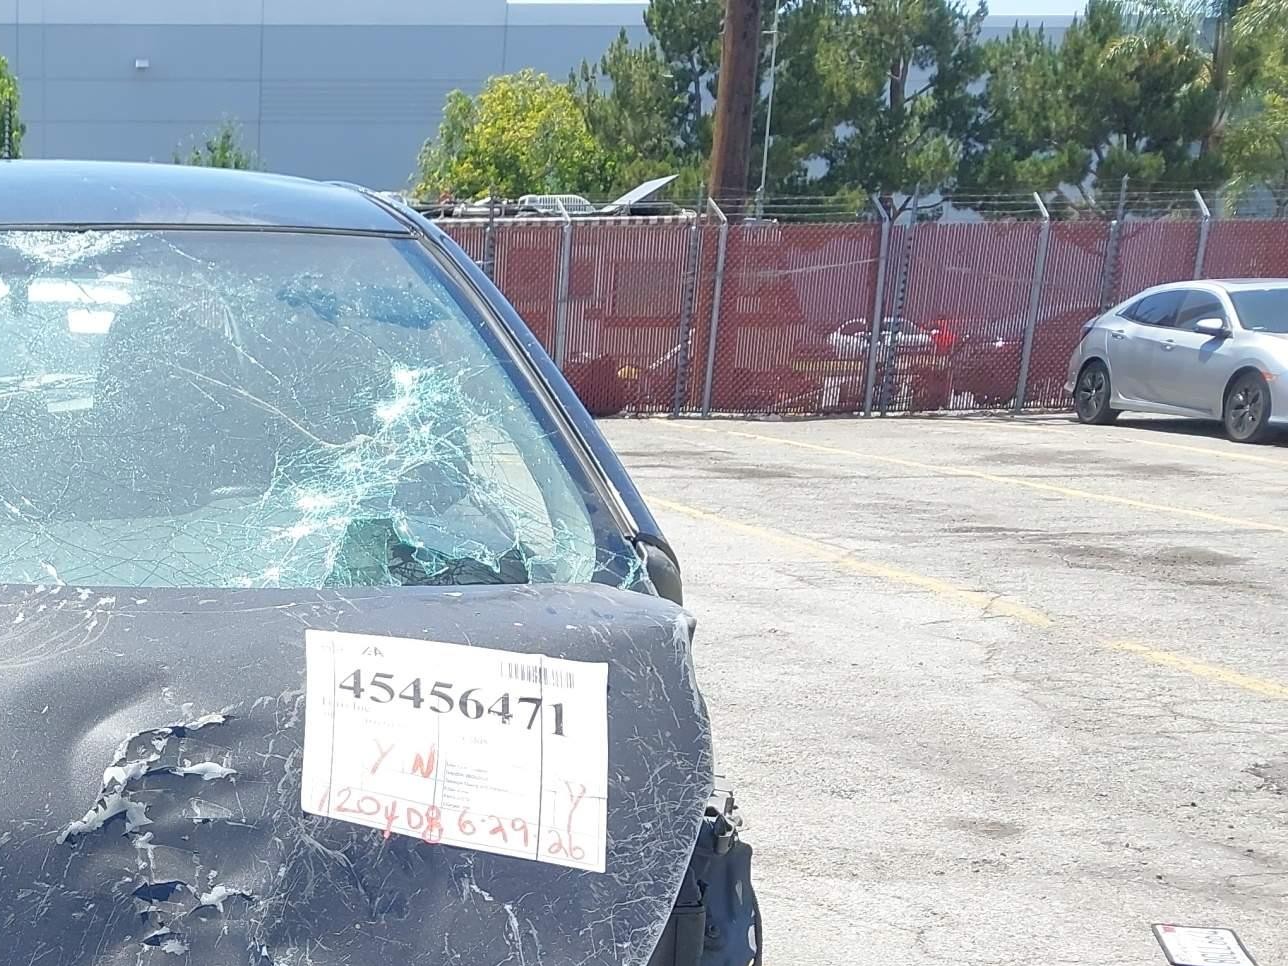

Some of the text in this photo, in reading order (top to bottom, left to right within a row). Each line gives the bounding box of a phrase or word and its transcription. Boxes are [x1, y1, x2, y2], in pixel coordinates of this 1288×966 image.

[338, 668, 566, 737] 45456471
[372, 738, 436, 778] Y N
